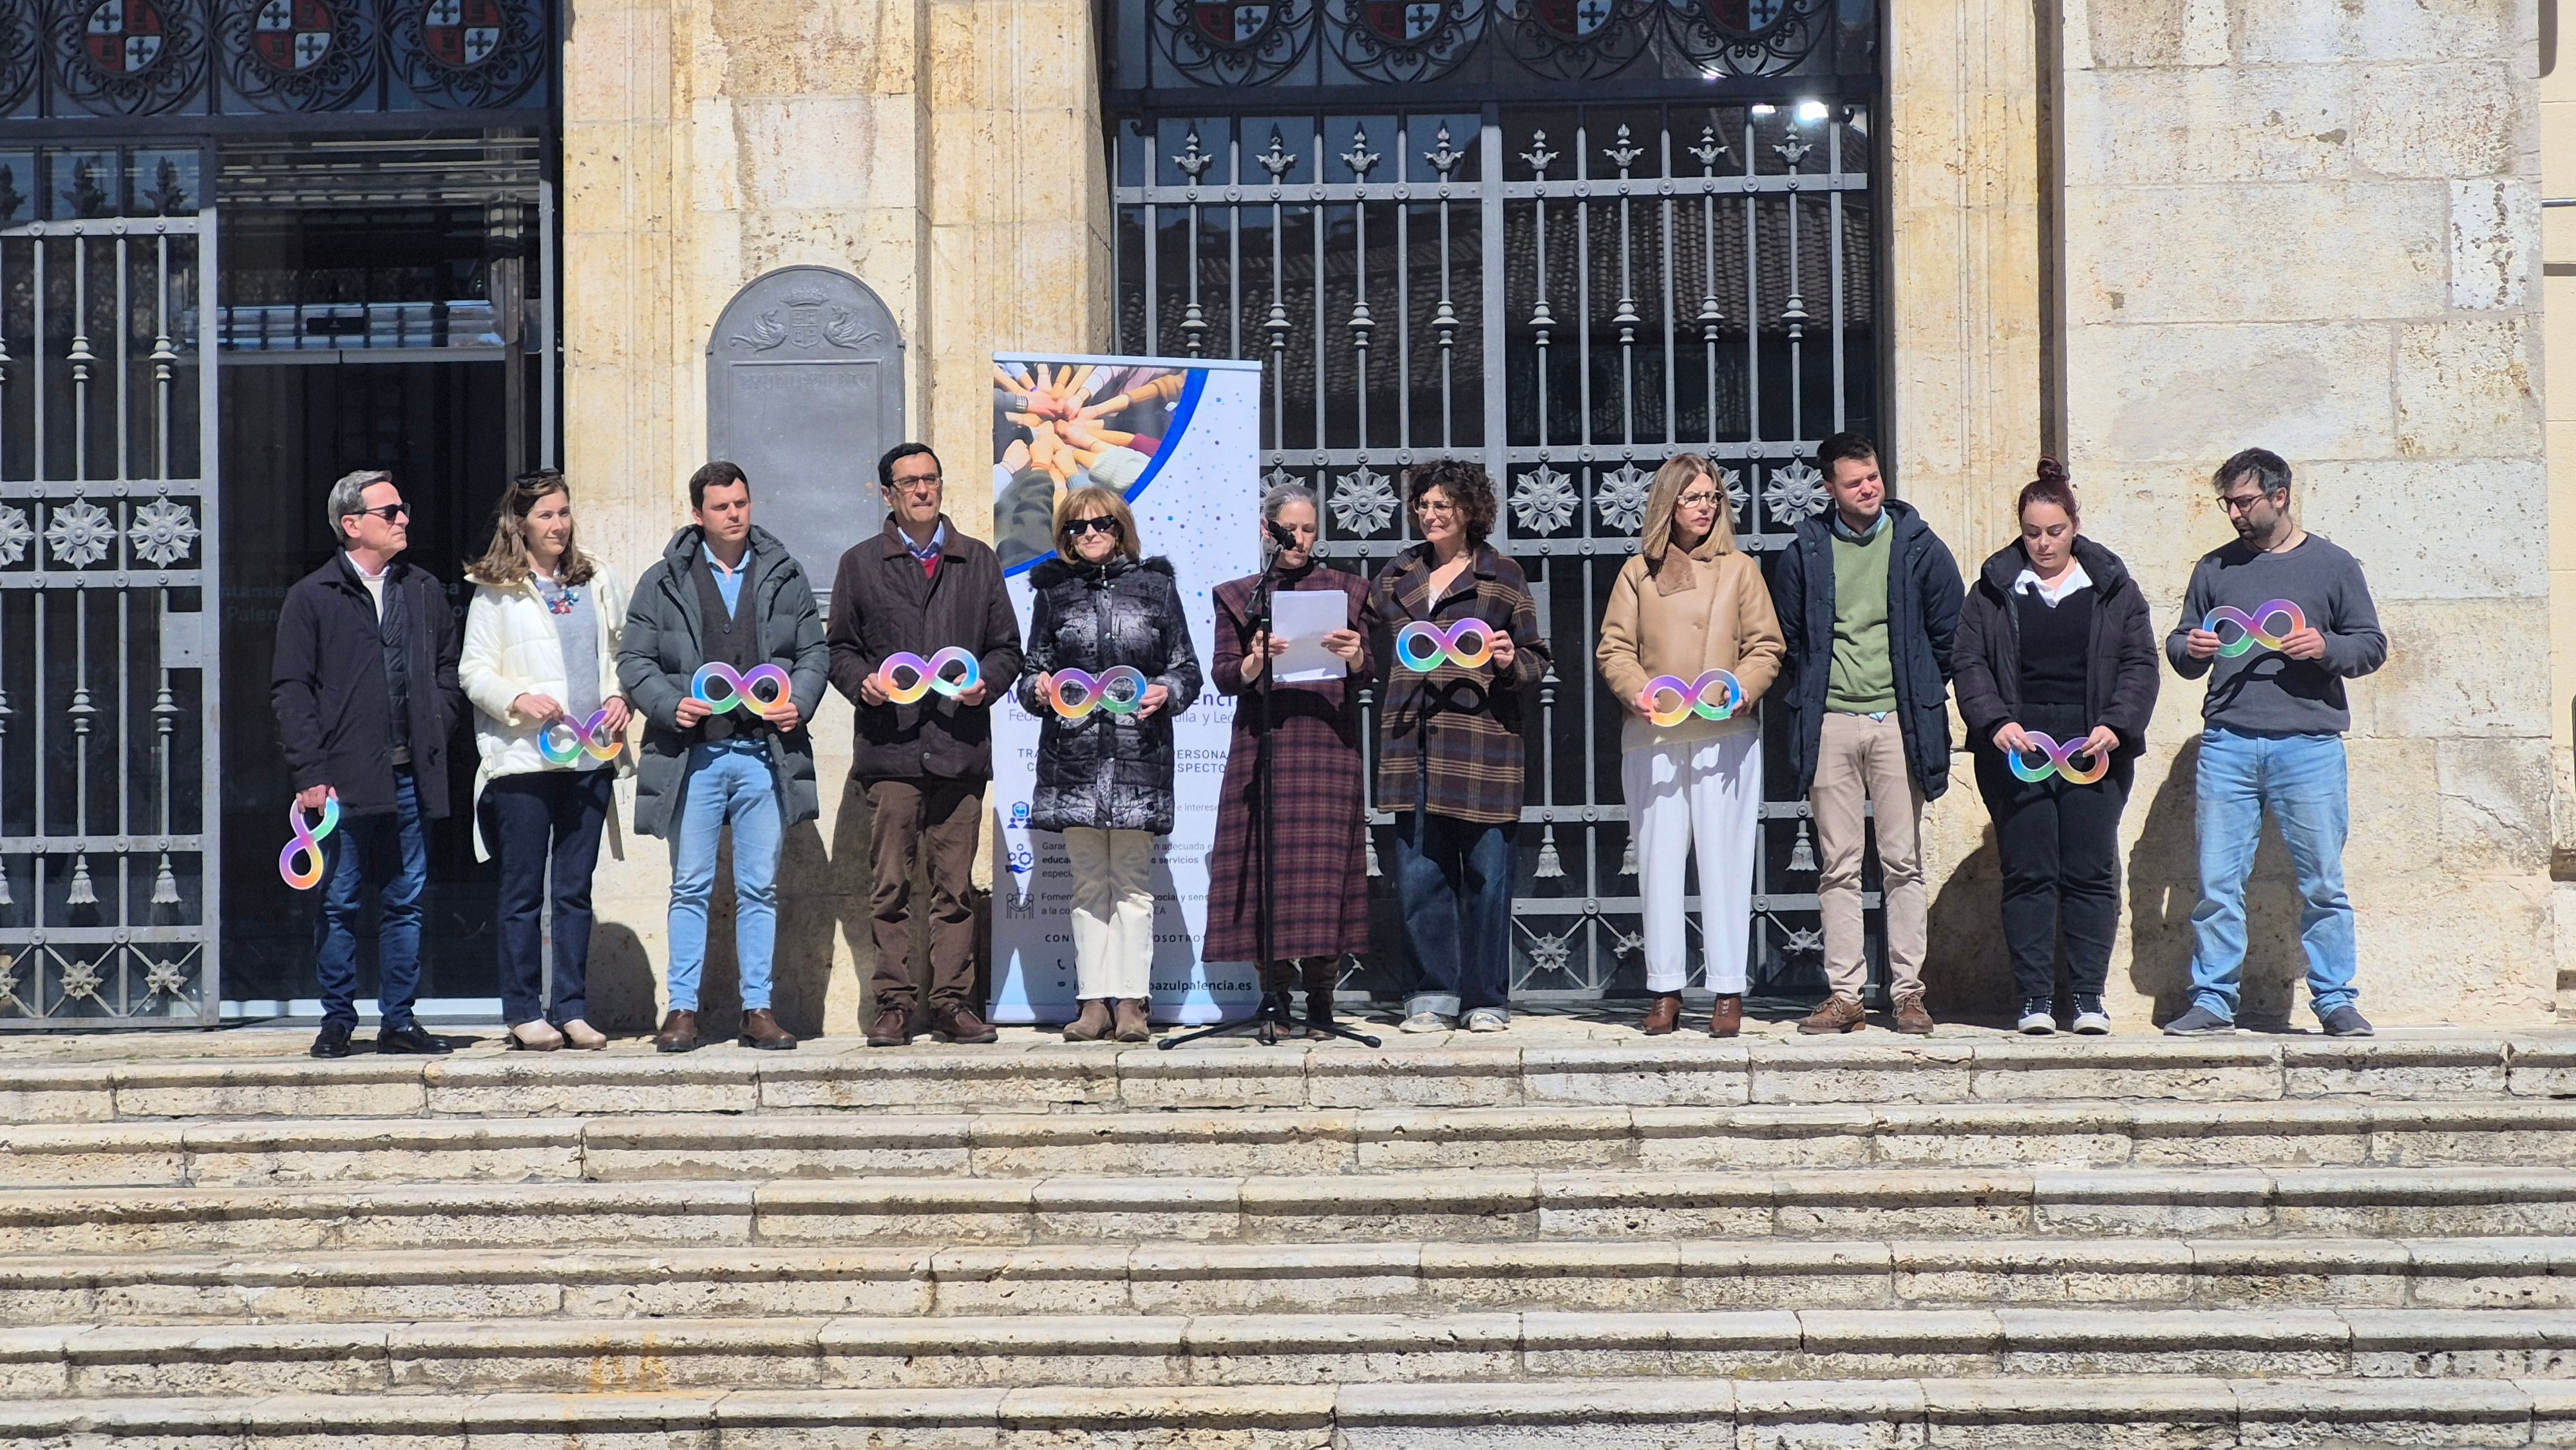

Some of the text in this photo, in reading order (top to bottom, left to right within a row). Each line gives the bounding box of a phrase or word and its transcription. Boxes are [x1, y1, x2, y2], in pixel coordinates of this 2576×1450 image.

[1202, 713, 1209, 726] y
[1162, 842, 1205, 851] adecuada
[1159, 856, 1199, 864] servicios
